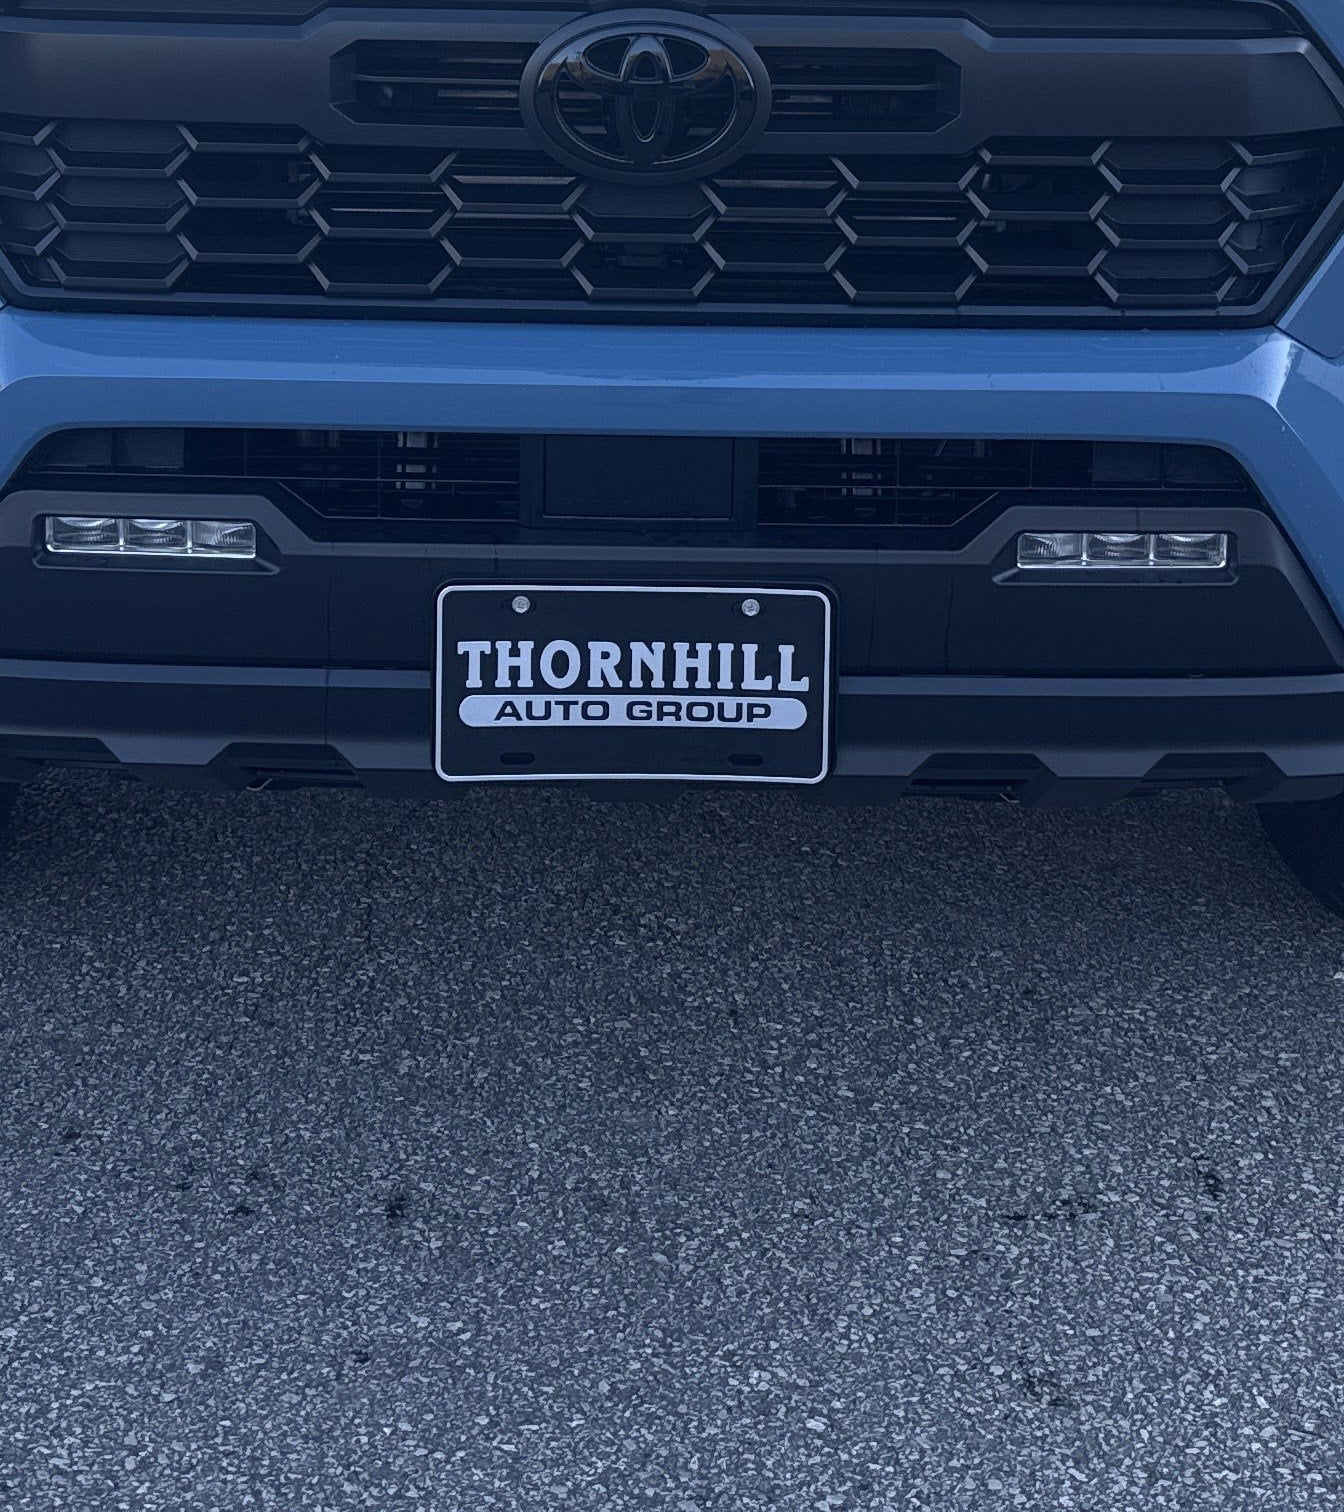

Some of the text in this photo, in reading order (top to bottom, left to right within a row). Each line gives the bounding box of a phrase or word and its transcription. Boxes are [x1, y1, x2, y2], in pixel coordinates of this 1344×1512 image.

[457, 639, 810, 692] THORNHILL
[494, 700, 772, 723] AUTO GROUP
